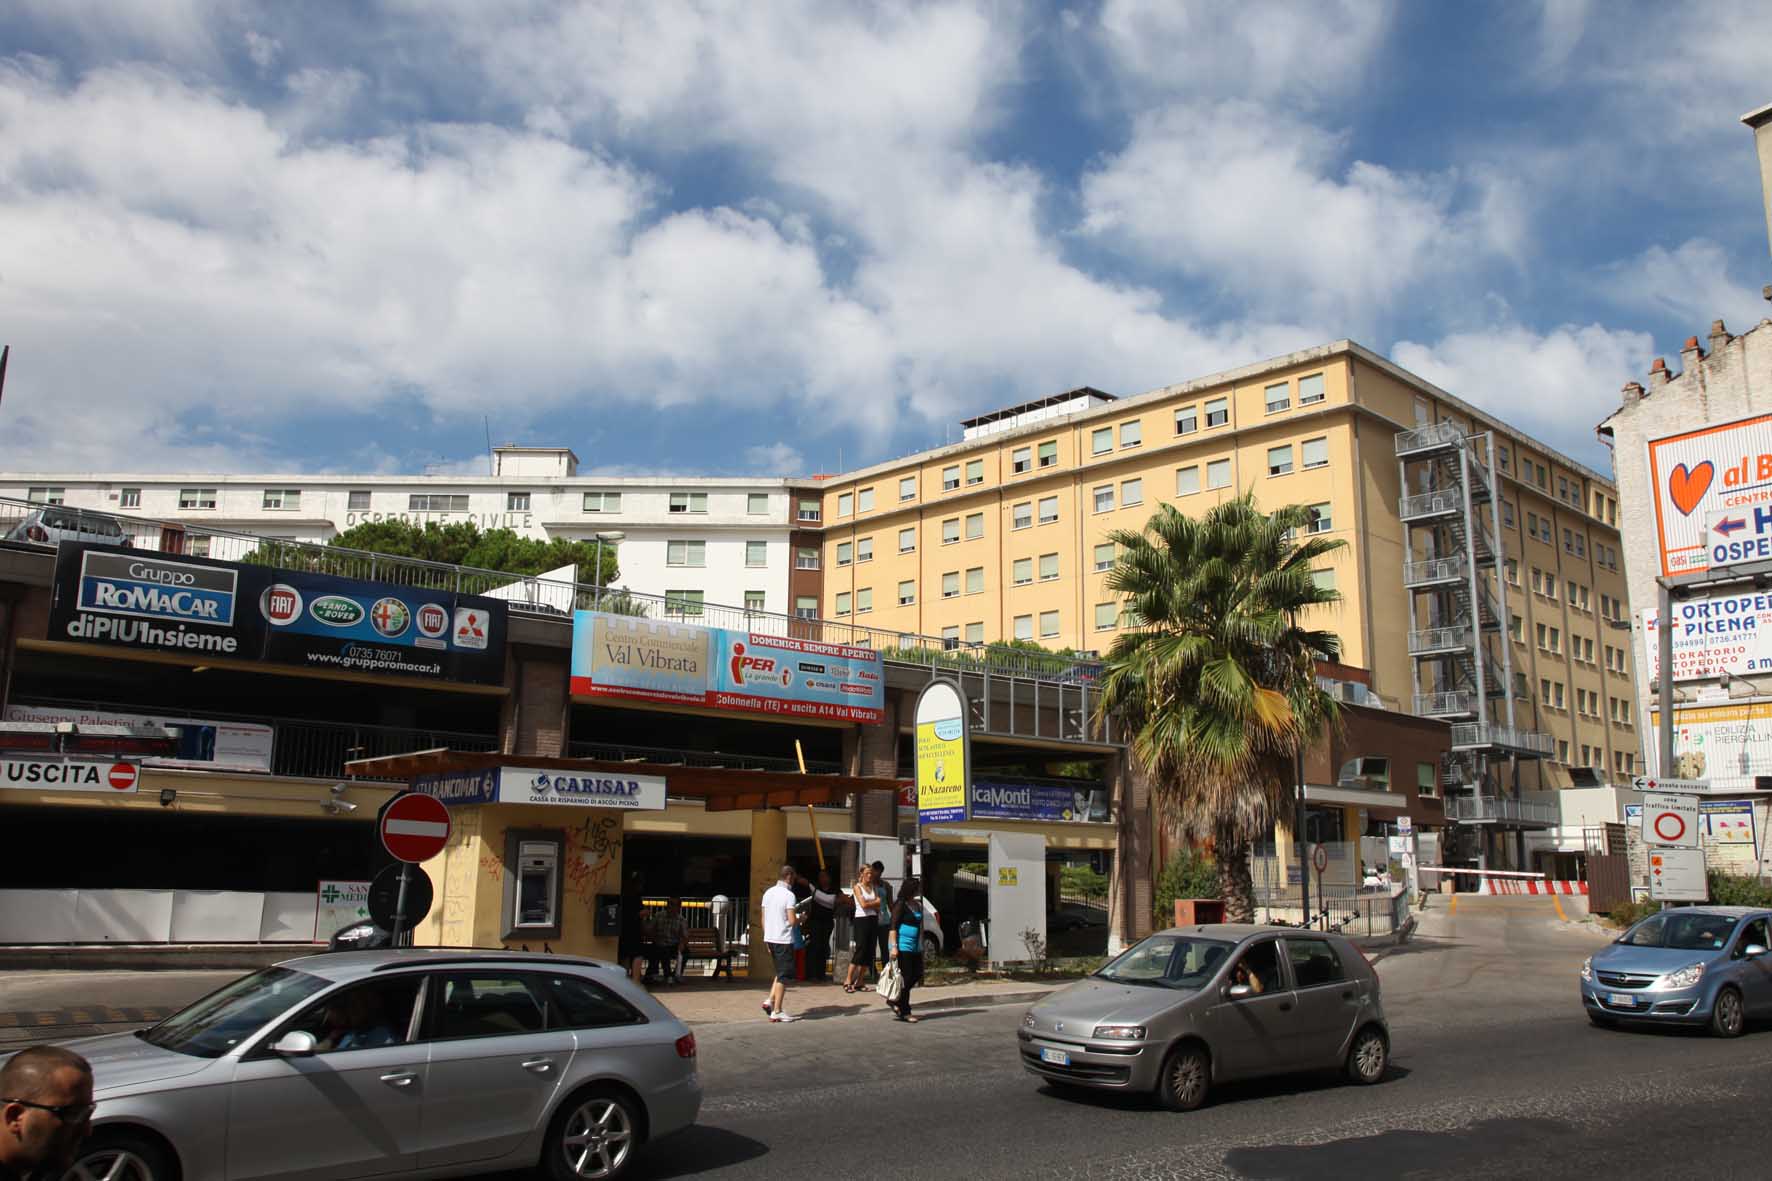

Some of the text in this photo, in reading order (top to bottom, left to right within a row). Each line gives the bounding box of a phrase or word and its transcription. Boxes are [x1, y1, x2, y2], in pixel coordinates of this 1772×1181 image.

[1724, 456, 1749, 487] al
[1726, 491, 1772, 507] CENTR
[468, 513, 534, 528] CIVILE
[1713, 537, 1772, 562] OSPE
[129, 562, 195, 586] Gruppo
[270, 597, 294, 614] FIAT
[322, 602, 347, 611] LAND
[325, 610, 355, 620] ROVER
[425, 614, 441, 628] FIAT
[1685, 616, 1756, 636] PICENA
[605, 631, 698, 651] Centro Commerciale
[752, 635, 875, 660] DOMENICA SEMPRE APERTO
[350, 647, 402, 661] 0735 76071
[606, 643, 697, 673] Val Vibrata
[1655, 646, 1745, 662] LBORATORIO
[307, 652, 441, 674] www.grupporomacar.it
[1656, 656, 1738, 670] OTOPEDICO
[717, 694, 877, 720] Colonnella (TE) uscita A14 Val Vibrata
[79, 713, 135, 727] Palestini
[1714, 724, 1756, 735] EDILIZIA
[7, 763, 100, 784] USCITA
[432, 777, 480, 800] BANCOMAT
[554, 776, 639, 796] CARISAP
[928, 785, 962, 795] Nazareno
[558, 797, 590, 805] RISPARMIO
[618, 799, 639, 807] PICENO
